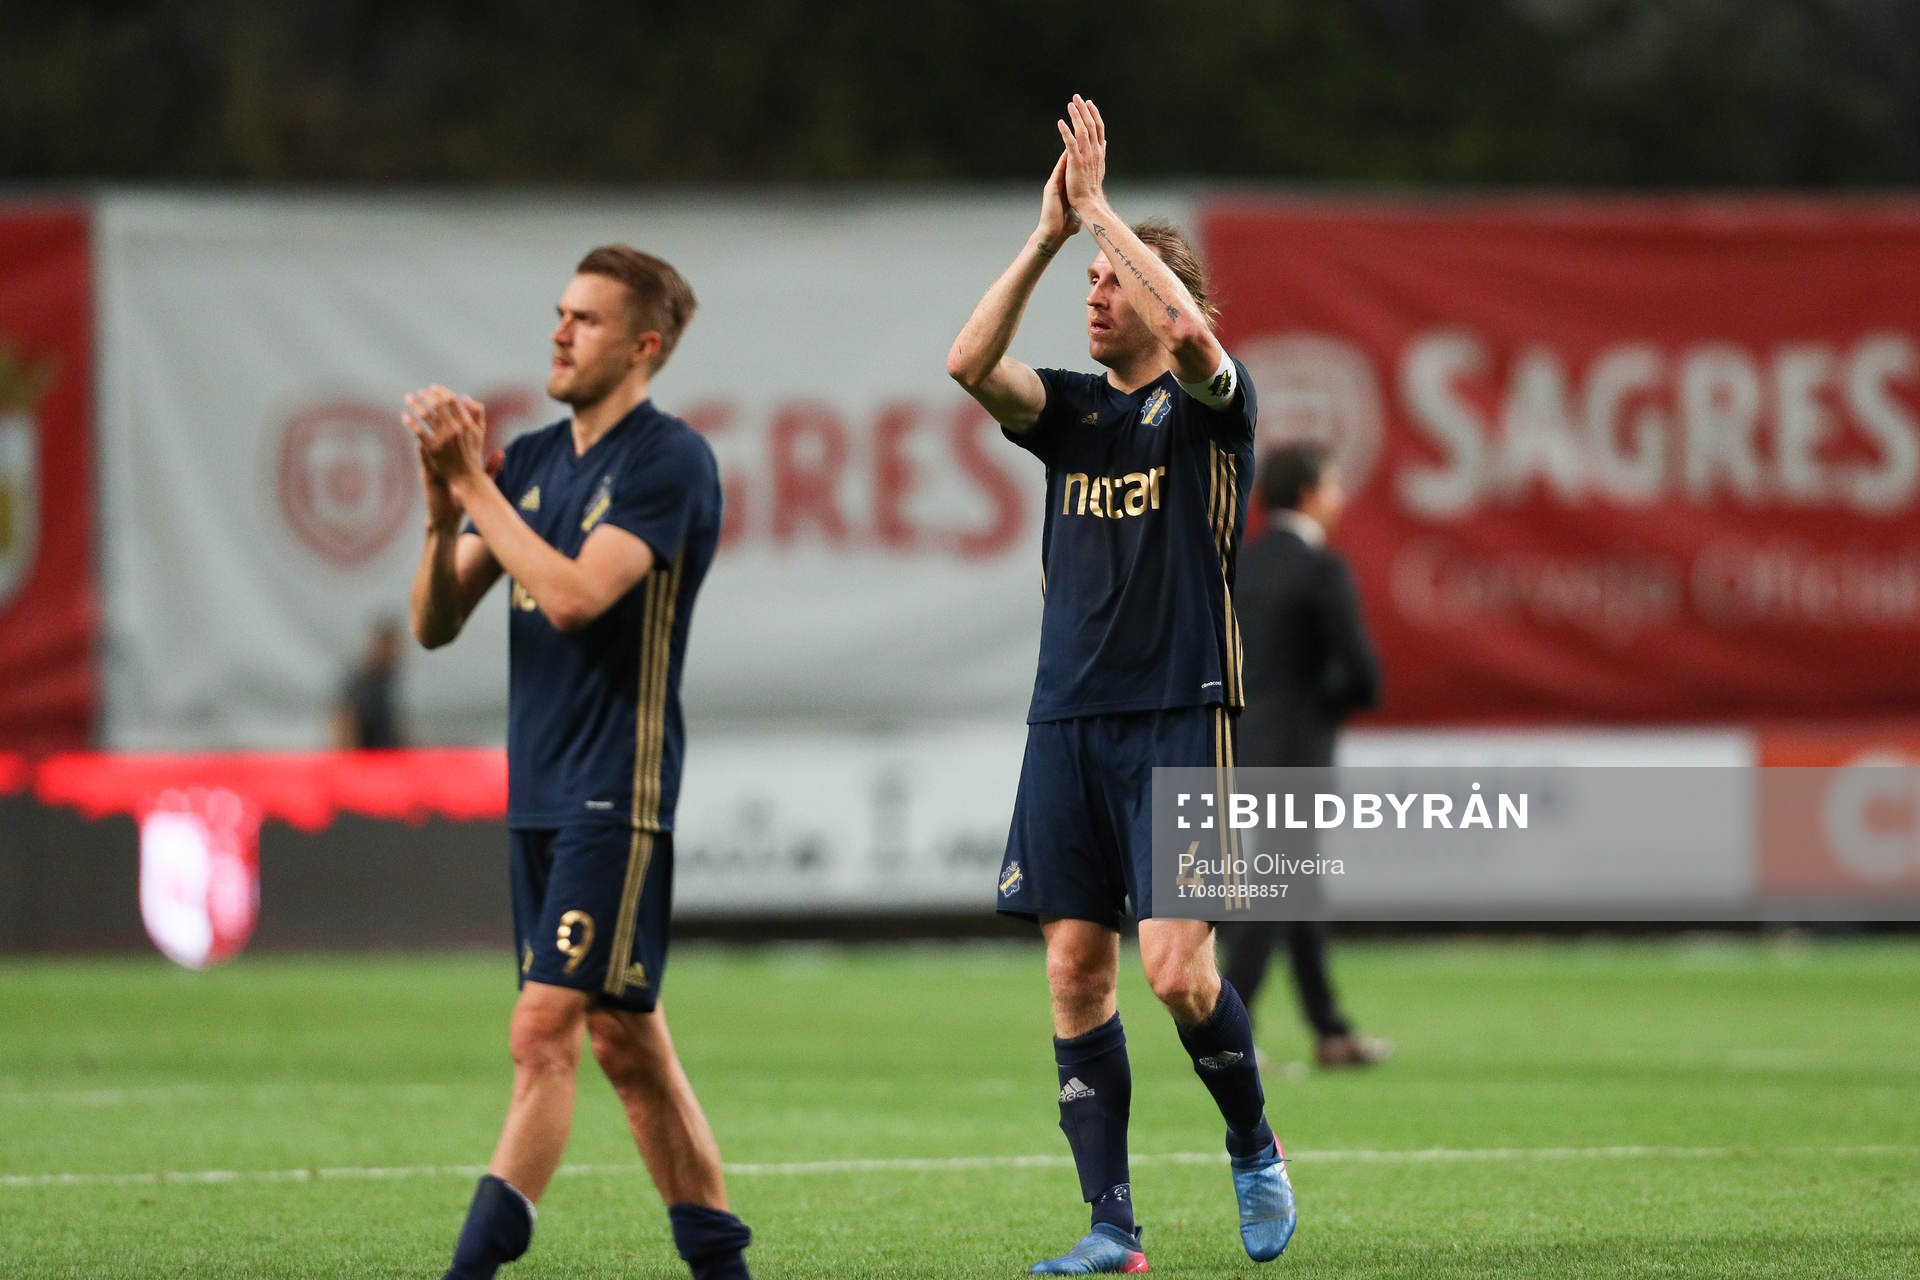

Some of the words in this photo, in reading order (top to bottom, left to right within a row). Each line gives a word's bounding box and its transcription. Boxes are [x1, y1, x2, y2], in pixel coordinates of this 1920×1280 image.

[484, 386, 1029, 564] RES
[1396, 328, 1920, 520] SAGRES
[1176, 840, 1204, 897] 4
[556, 909, 595, 974] 9
